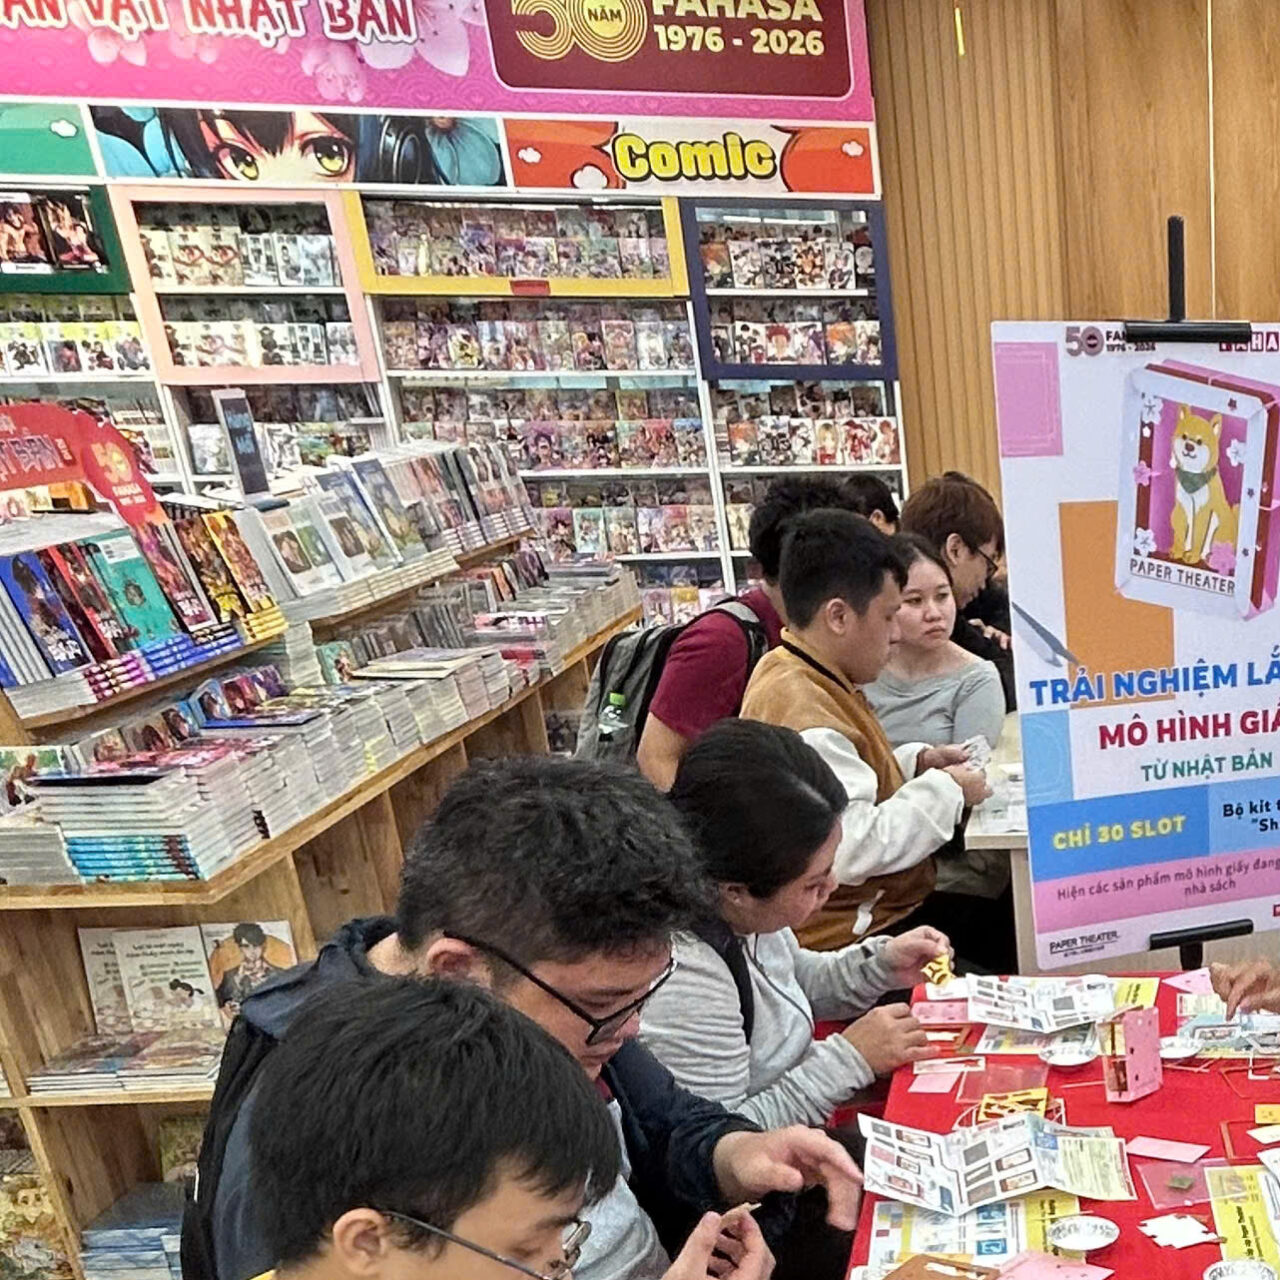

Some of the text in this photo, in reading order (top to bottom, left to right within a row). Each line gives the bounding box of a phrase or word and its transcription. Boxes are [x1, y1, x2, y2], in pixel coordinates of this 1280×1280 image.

[652, 0, 824, 22] FAHASA
[653, 25, 725, 53] 1976
[750, 28, 826, 56] 2026
[612, 131, 777, 181] Comic
[1065, 325, 1104, 357] 50
[1130, 557, 1236, 596] PAPER THEATER
[1029, 666, 1104, 707] TRẢI
[1114, 658, 1239, 699] NGHIỆM
[1098, 714, 1148, 750] MÔ
[1156, 710, 1232, 744] HÌNH
[1141, 748, 1274, 782] TỪ NHẬT BẢN
[1223, 803, 1245, 820] Bộ
[1249, 800, 1272, 815] kit
[1053, 814, 1188, 851] CHỈ 30 SLOT
[1057, 886, 1086, 901] Hiện
[1088, 880, 1110, 896] các
[1112, 877, 1134, 891] sản
[1137, 872, 1171, 891] phẩm
[1174, 868, 1194, 882] mô
[1196, 863, 1222, 879] hình
[1225, 860, 1251, 879] giấy
[1184, 878, 1237, 897] nhà sách
[1050, 936, 1078, 951] PAPER
[1079, 930, 1119, 945] THEATER
